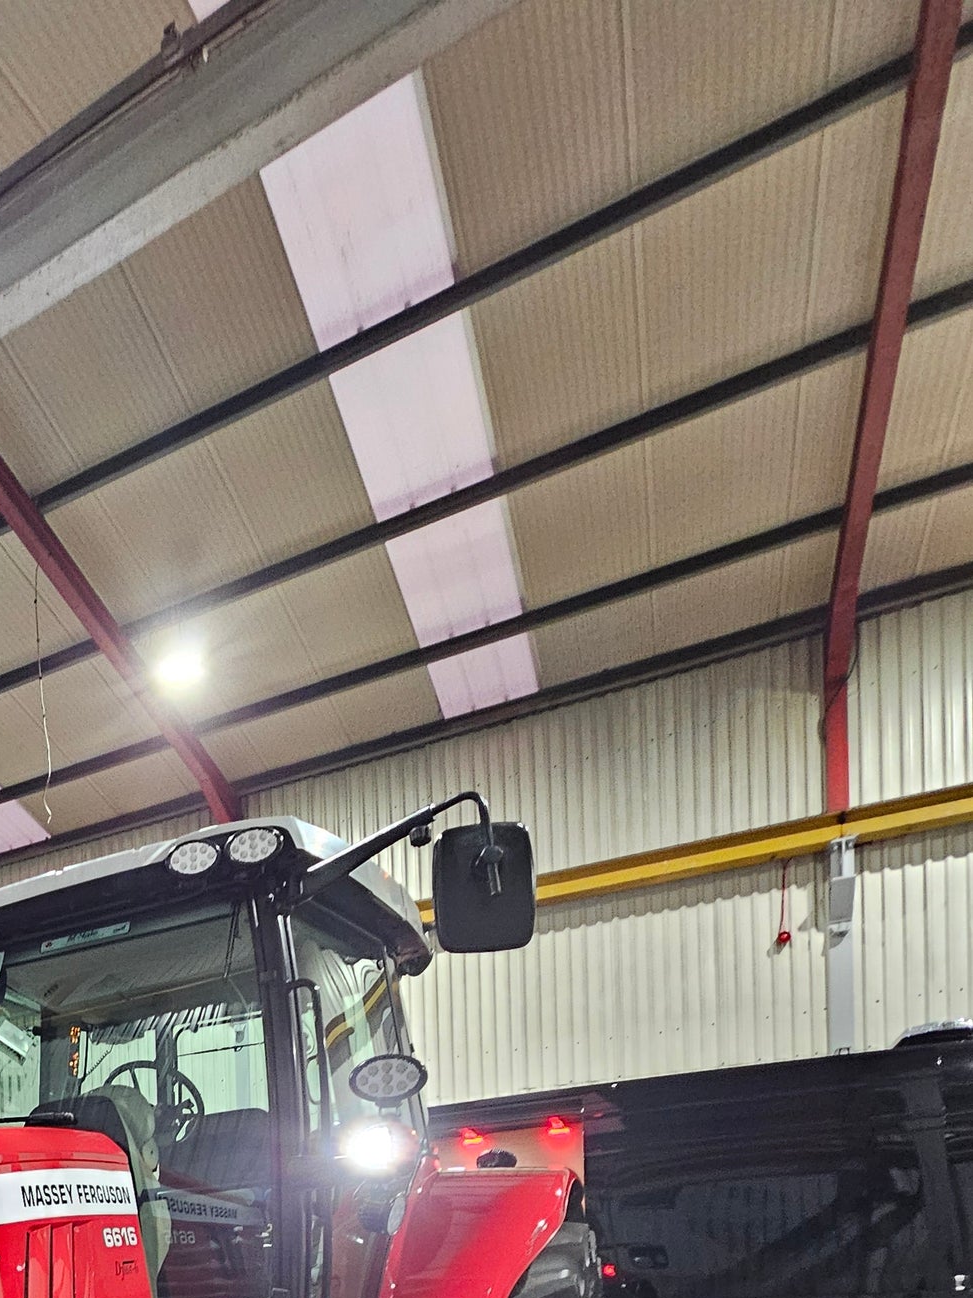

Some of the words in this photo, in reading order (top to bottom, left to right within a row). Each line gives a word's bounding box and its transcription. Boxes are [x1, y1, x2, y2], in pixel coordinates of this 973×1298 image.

[20, 1183, 73, 1208] MASSEY
[76, 1184, 131, 1204] FERGUSON
[102, 1226, 138, 1248] 6616
